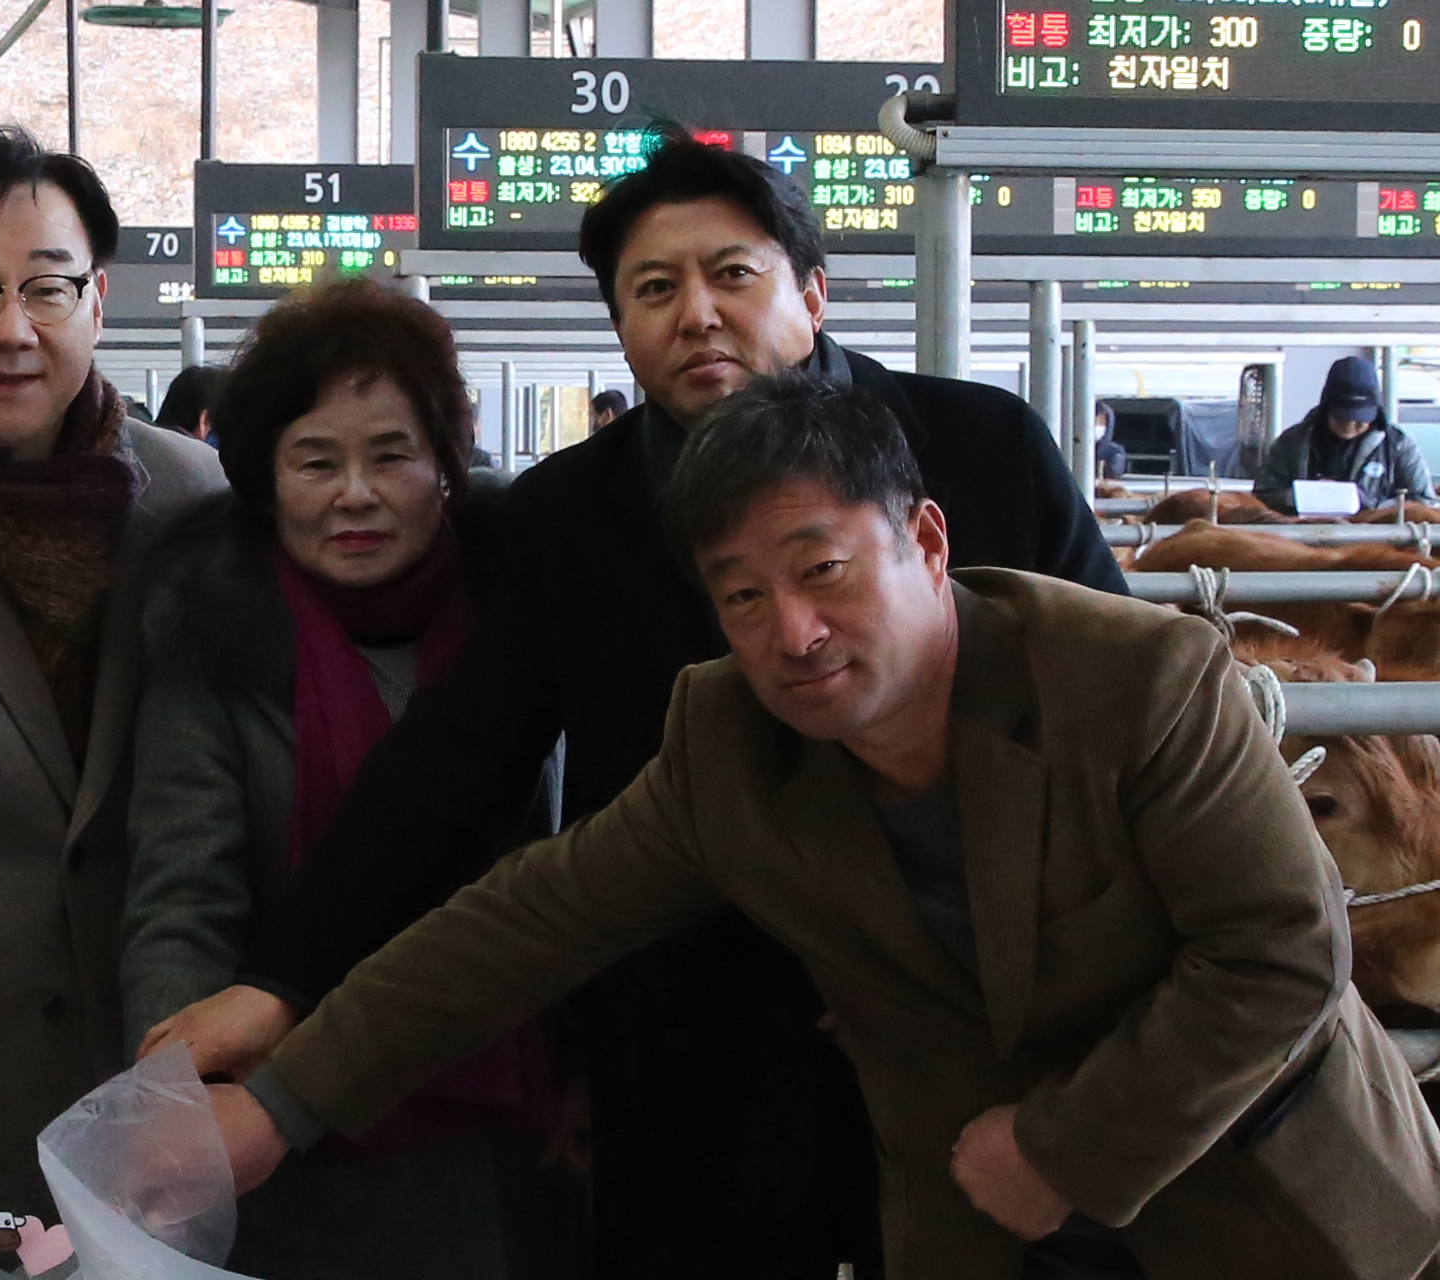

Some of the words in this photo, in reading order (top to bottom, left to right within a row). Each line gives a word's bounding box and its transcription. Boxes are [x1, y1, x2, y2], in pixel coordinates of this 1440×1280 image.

[1006, 12, 1069, 48] 혈통
[1088, 14, 1191, 49] 최저가:
[1209, 16, 1258, 48] 300
[1301, 18, 1372, 53] 중량:
[1403, 19, 1421, 51] 0
[1007, 56, 1079, 90] 비고:
[1108, 54, 1229, 90] 친자일치
[571, 70, 630, 114] 30
[451, 132, 491, 172] 수
[584, 131, 597, 152] 2
[767, 135, 807, 175] 수
[305, 172, 340, 203] 51
[497, 181, 561, 203] 최저가:
[813, 184, 875, 206] 최저가:
[884, 184, 915, 205] 310
[1122, 187, 1183, 213] 최저가:
[1302, 189, 1316, 210] 0
[217, 215, 246, 245] 수
[447, 206, 494, 228] 비고:
[1073, 212, 1119, 233] 비고:
[146, 232, 179, 257] 70
[384, 250, 395, 266] 0
